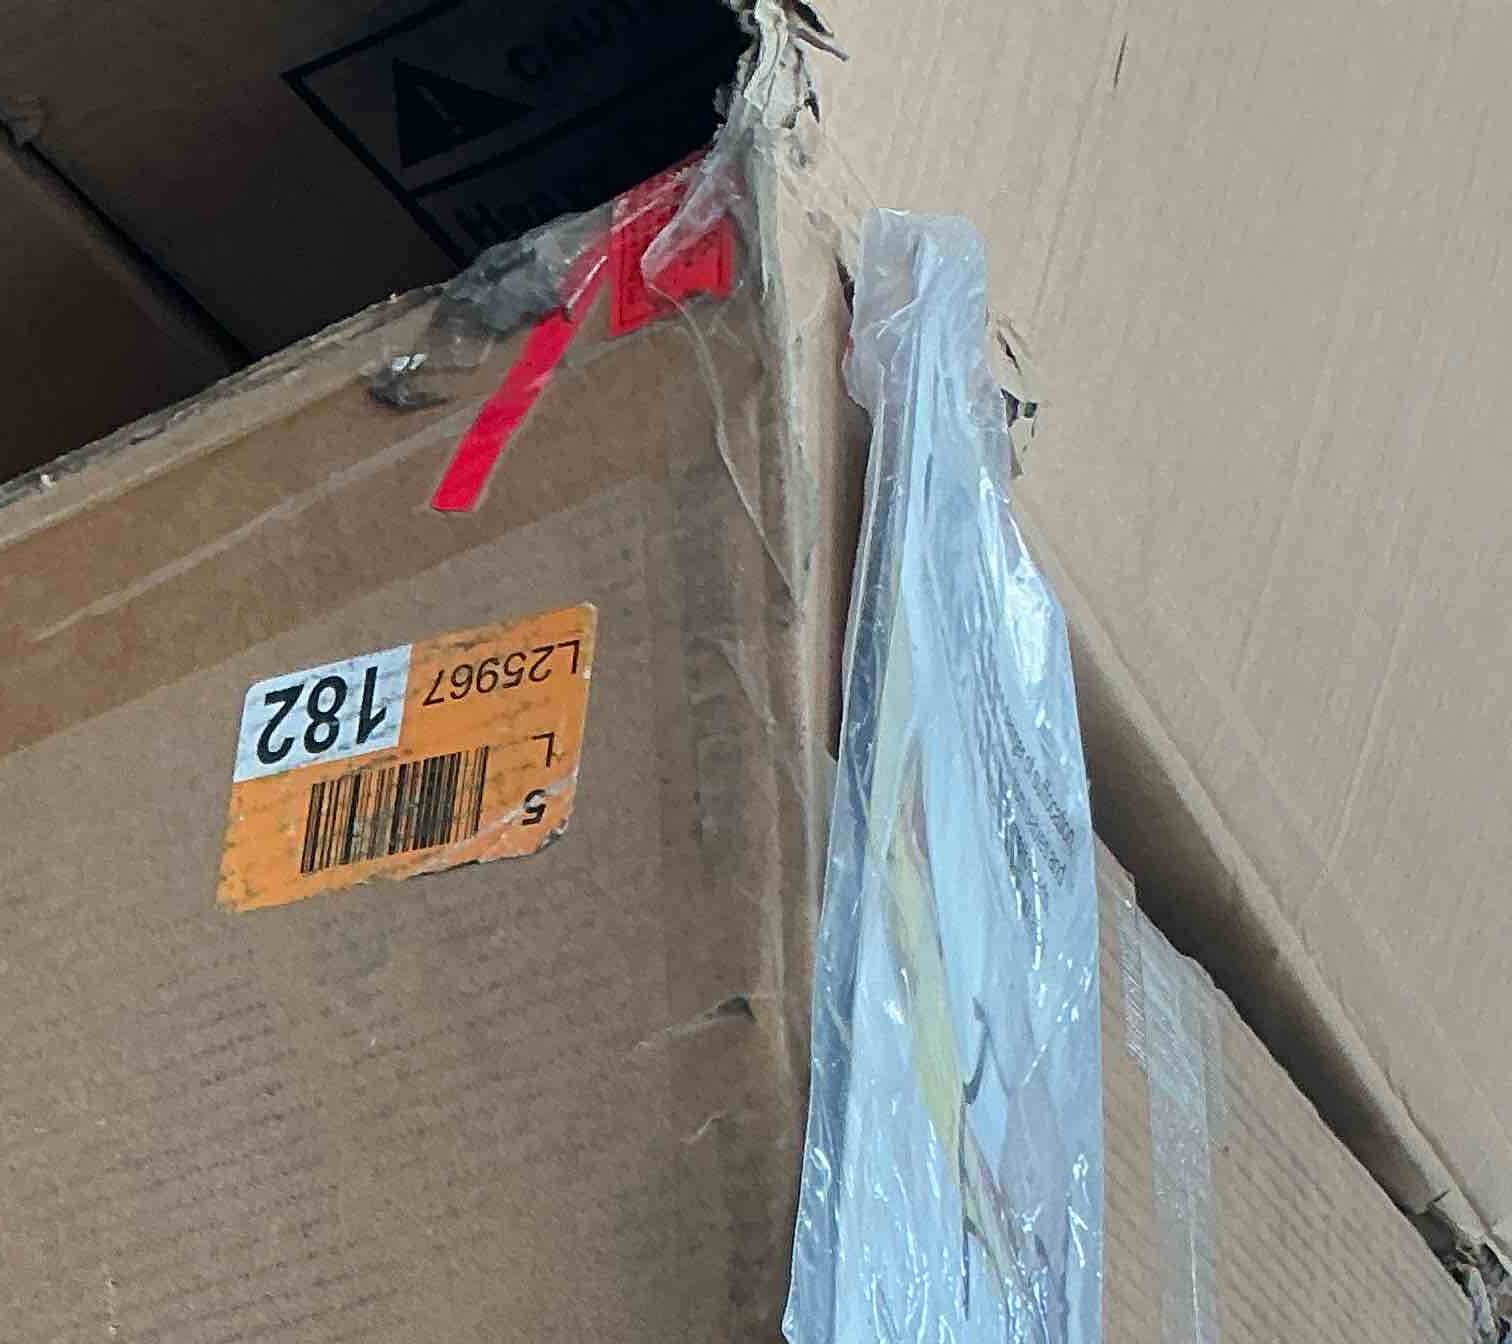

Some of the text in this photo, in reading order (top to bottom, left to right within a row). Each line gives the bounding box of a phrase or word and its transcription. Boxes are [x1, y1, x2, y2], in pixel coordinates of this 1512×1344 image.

[421, 639, 581, 706] L25967
[256, 666, 388, 765] 182
[531, 731, 555, 769] L
